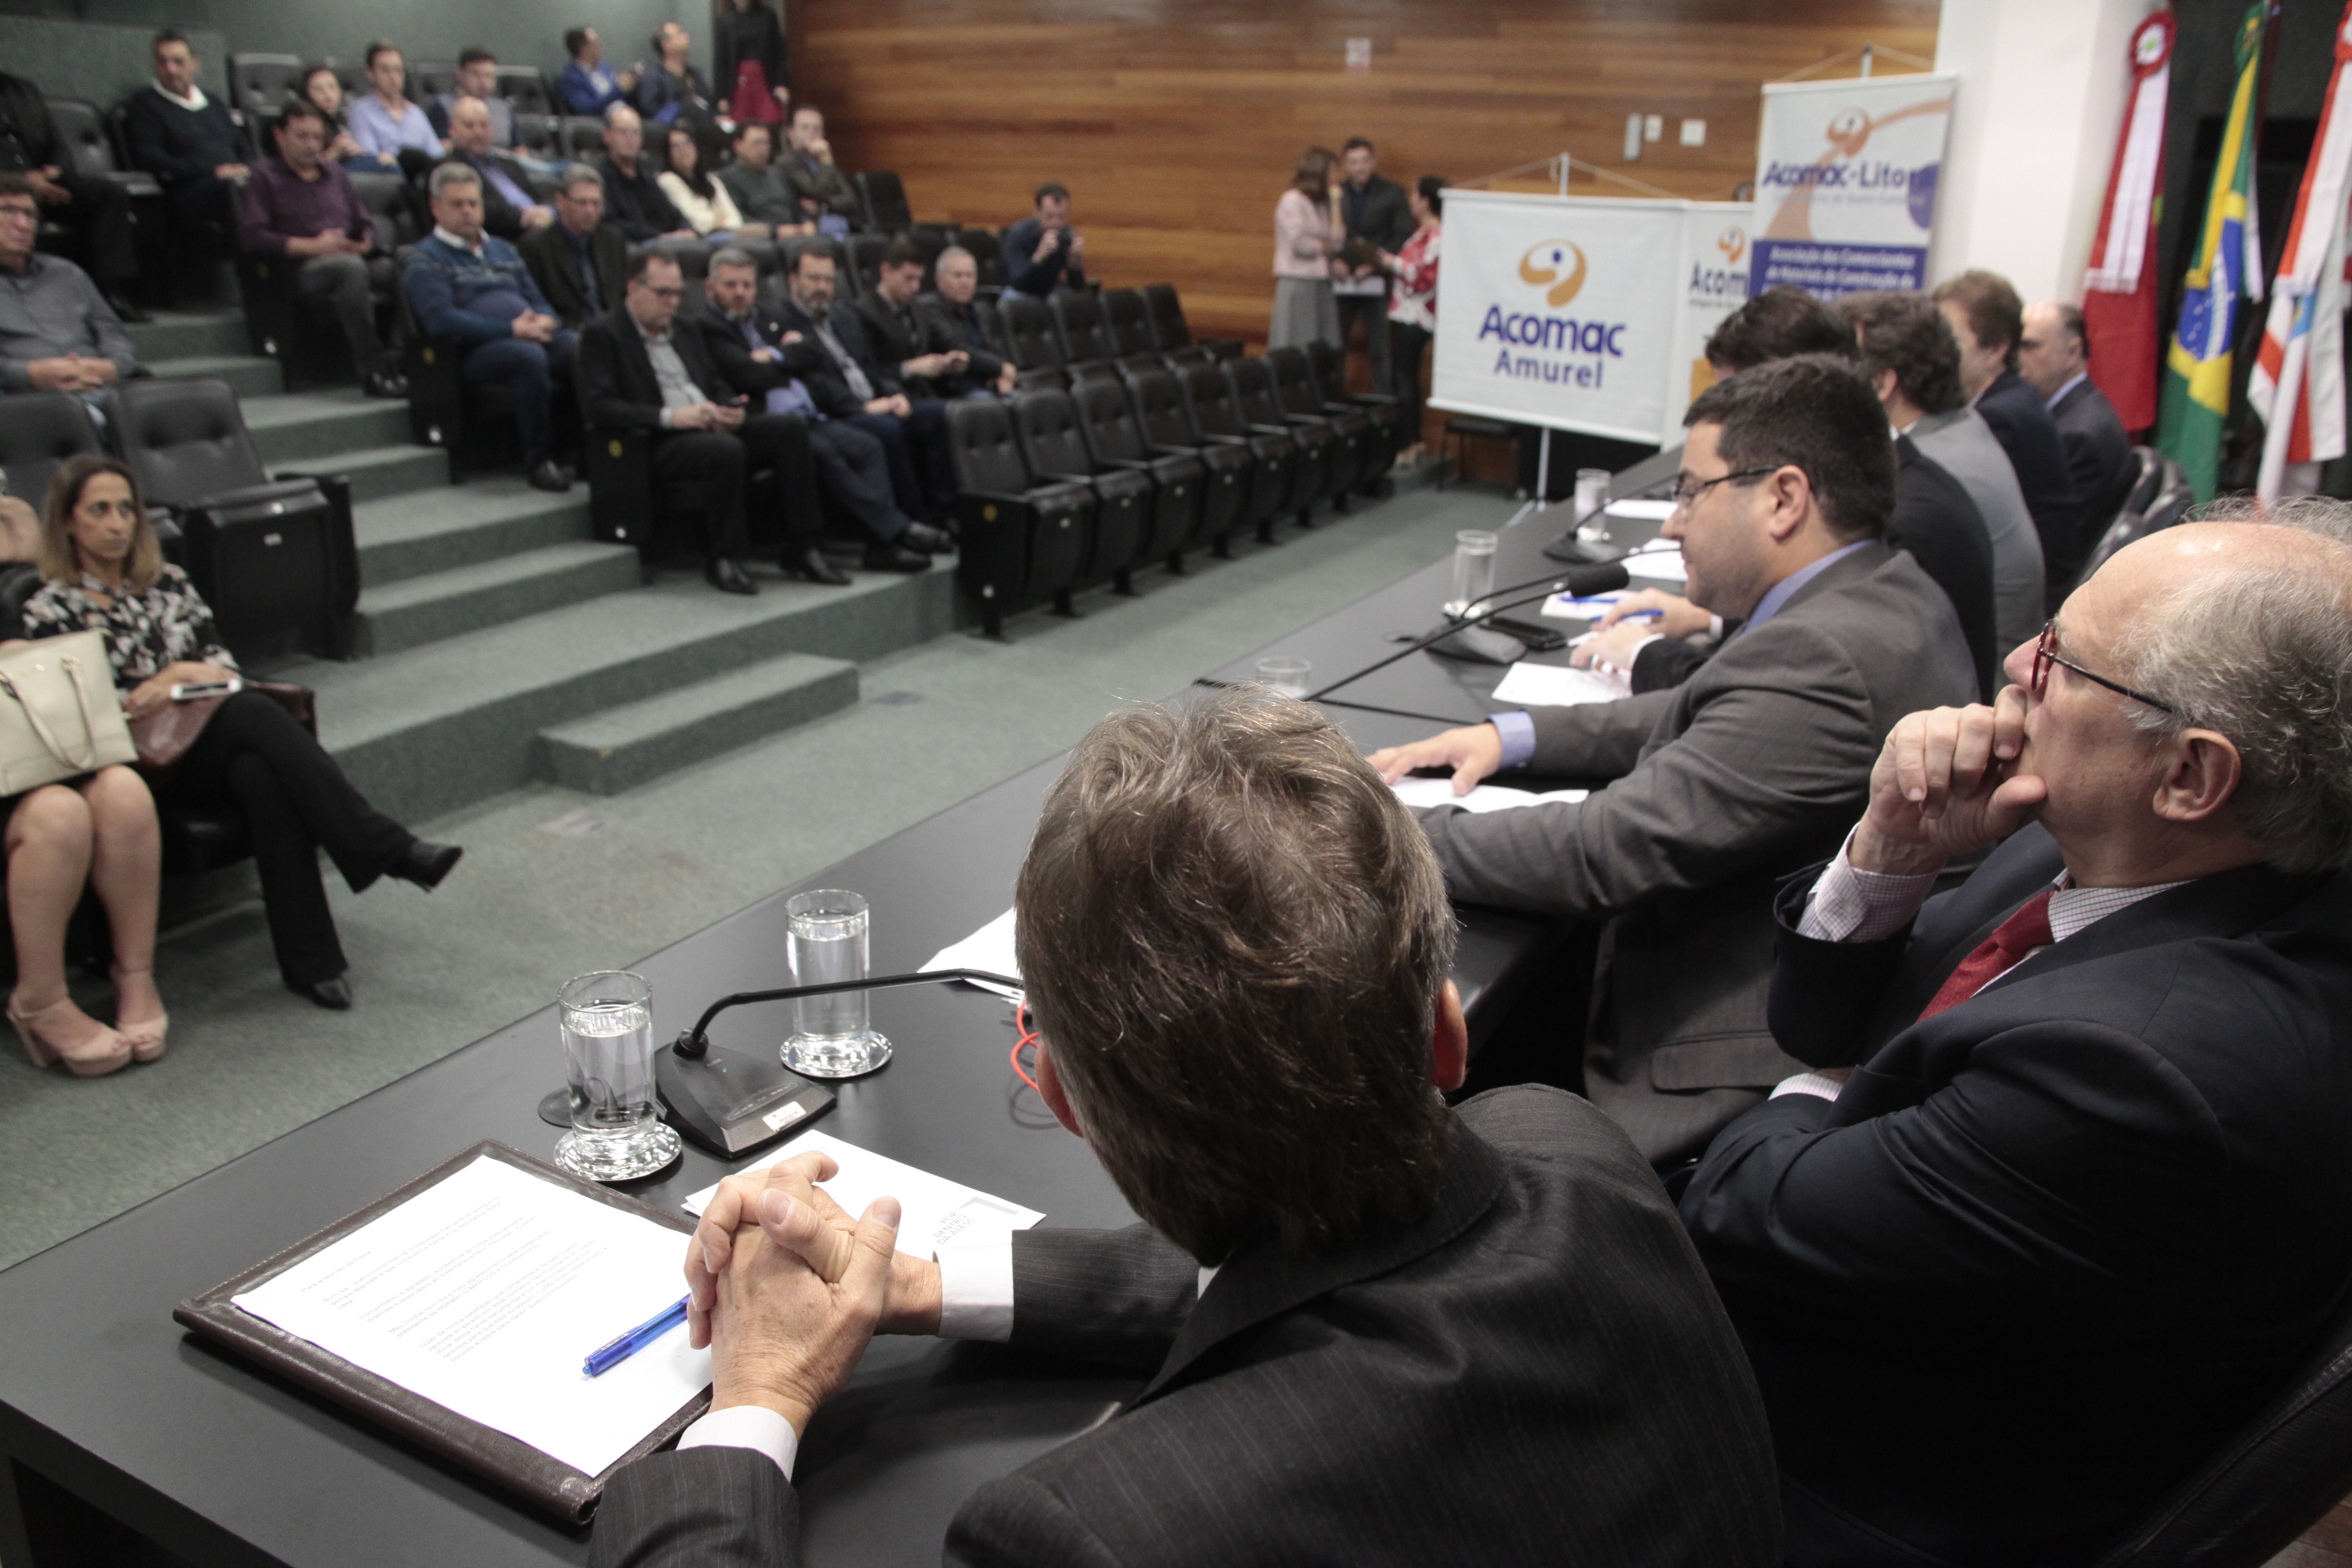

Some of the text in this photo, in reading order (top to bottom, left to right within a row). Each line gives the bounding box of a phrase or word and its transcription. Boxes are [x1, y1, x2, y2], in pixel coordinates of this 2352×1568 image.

[1687, 261, 1748, 295] Acom
[1479, 303, 1627, 358] Acomac
[1494, 348, 1605, 389] Amurel
[933, 1215, 966, 1238] DENTRO
[937, 1218, 975, 1244] DA ALESC
[940, 1212, 958, 1223] POR
